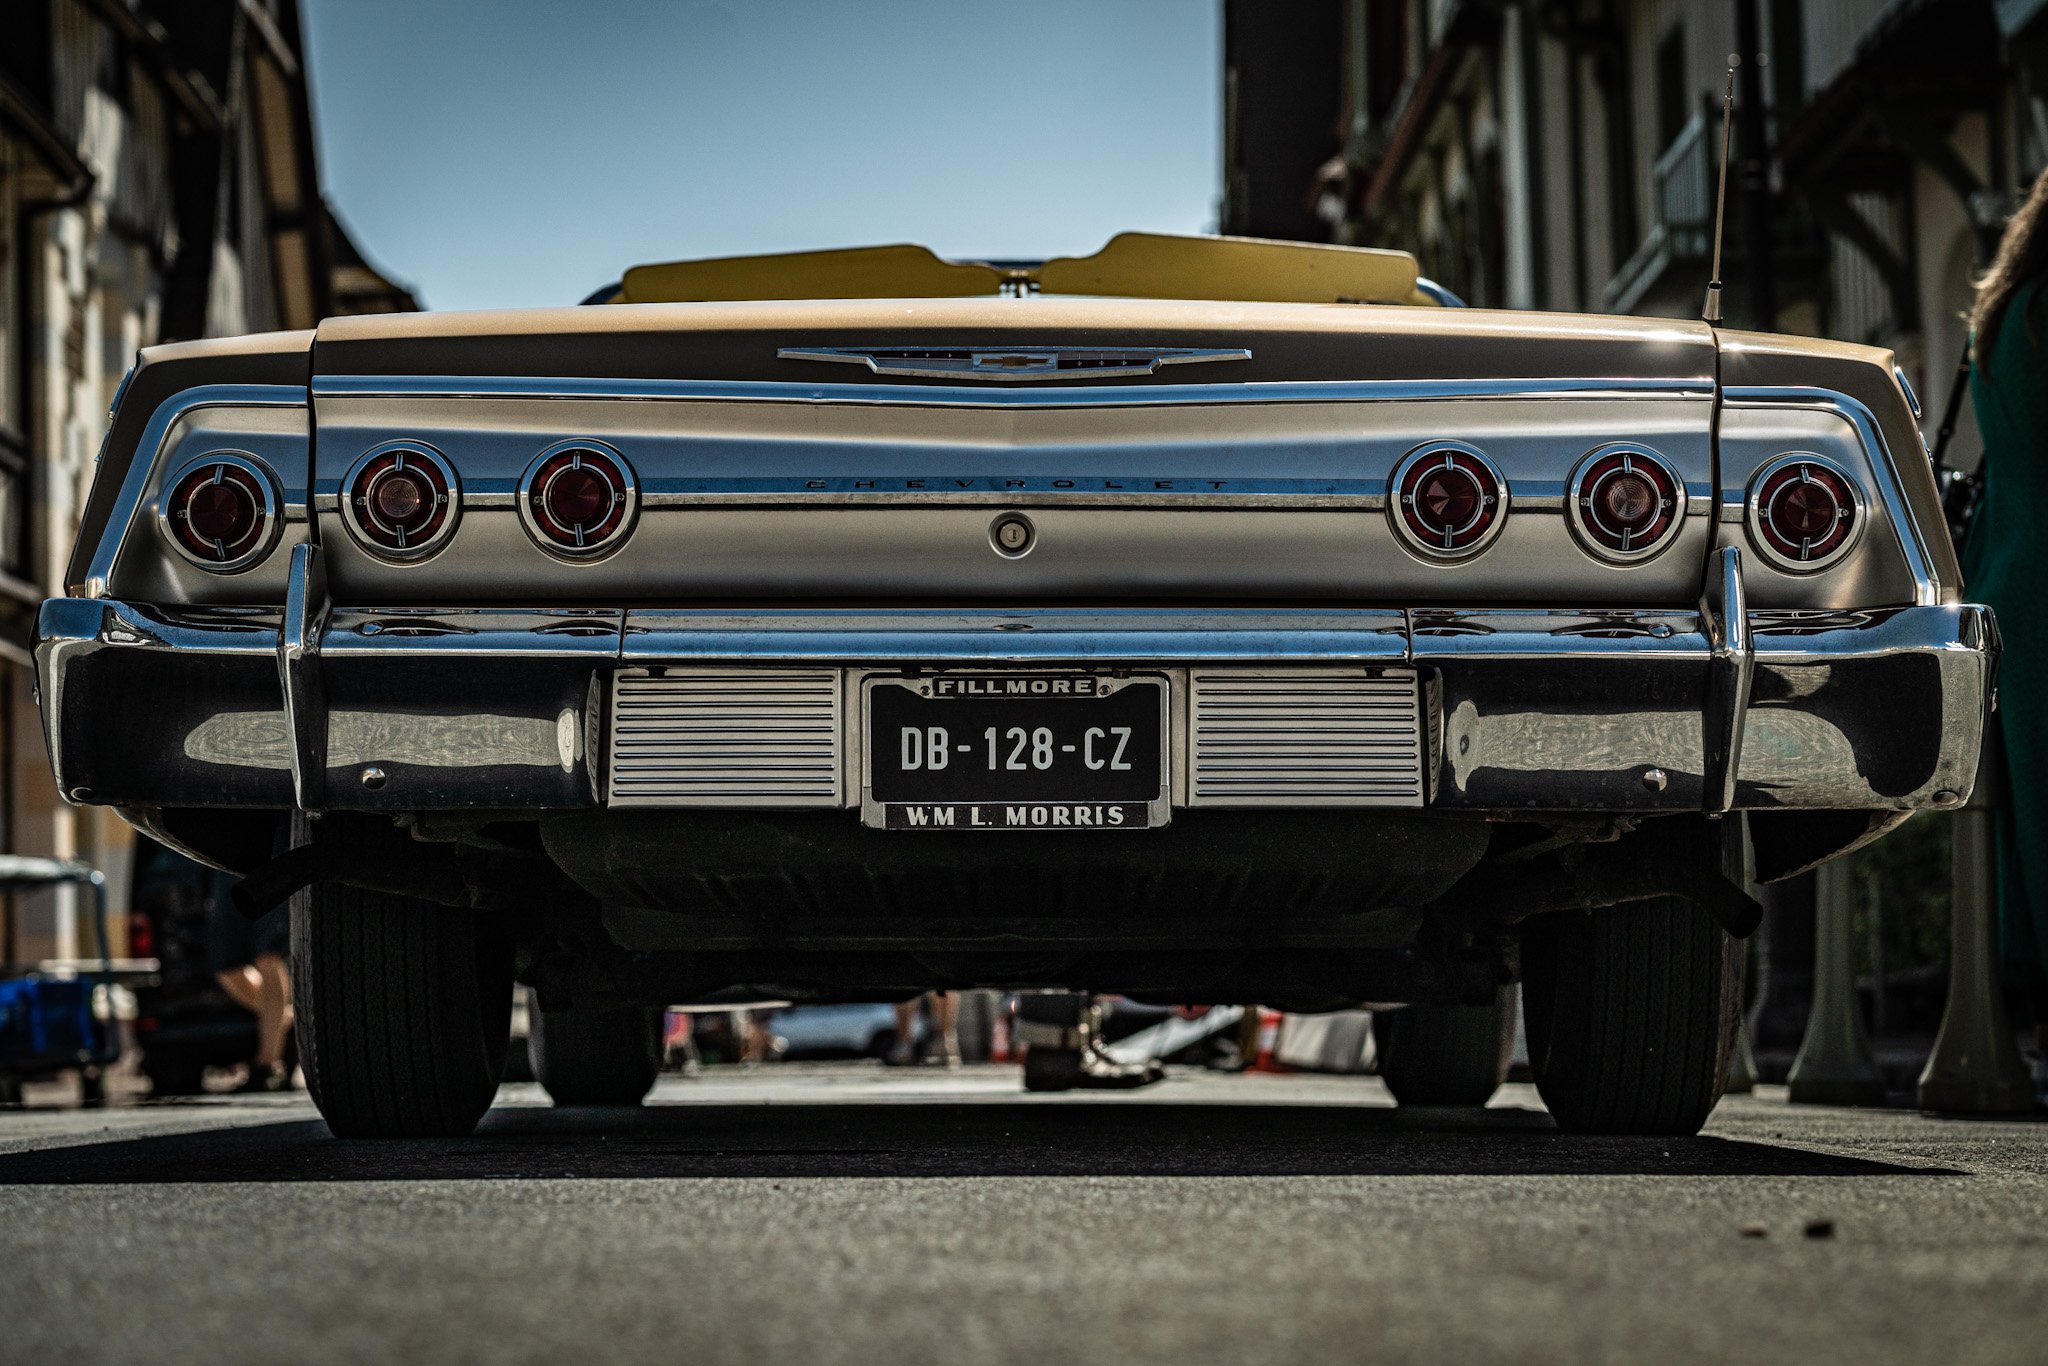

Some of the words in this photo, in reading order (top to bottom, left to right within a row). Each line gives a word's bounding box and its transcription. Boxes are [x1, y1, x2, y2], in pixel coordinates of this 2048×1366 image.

[805, 479, 1229, 490] CHEVROLET
[938, 680, 1092, 694] FILLMORE
[901, 726, 1132, 771] DB-128-CZ
[971, 806, 993, 826] L.
[1006, 806, 1124, 826] MORRIS
